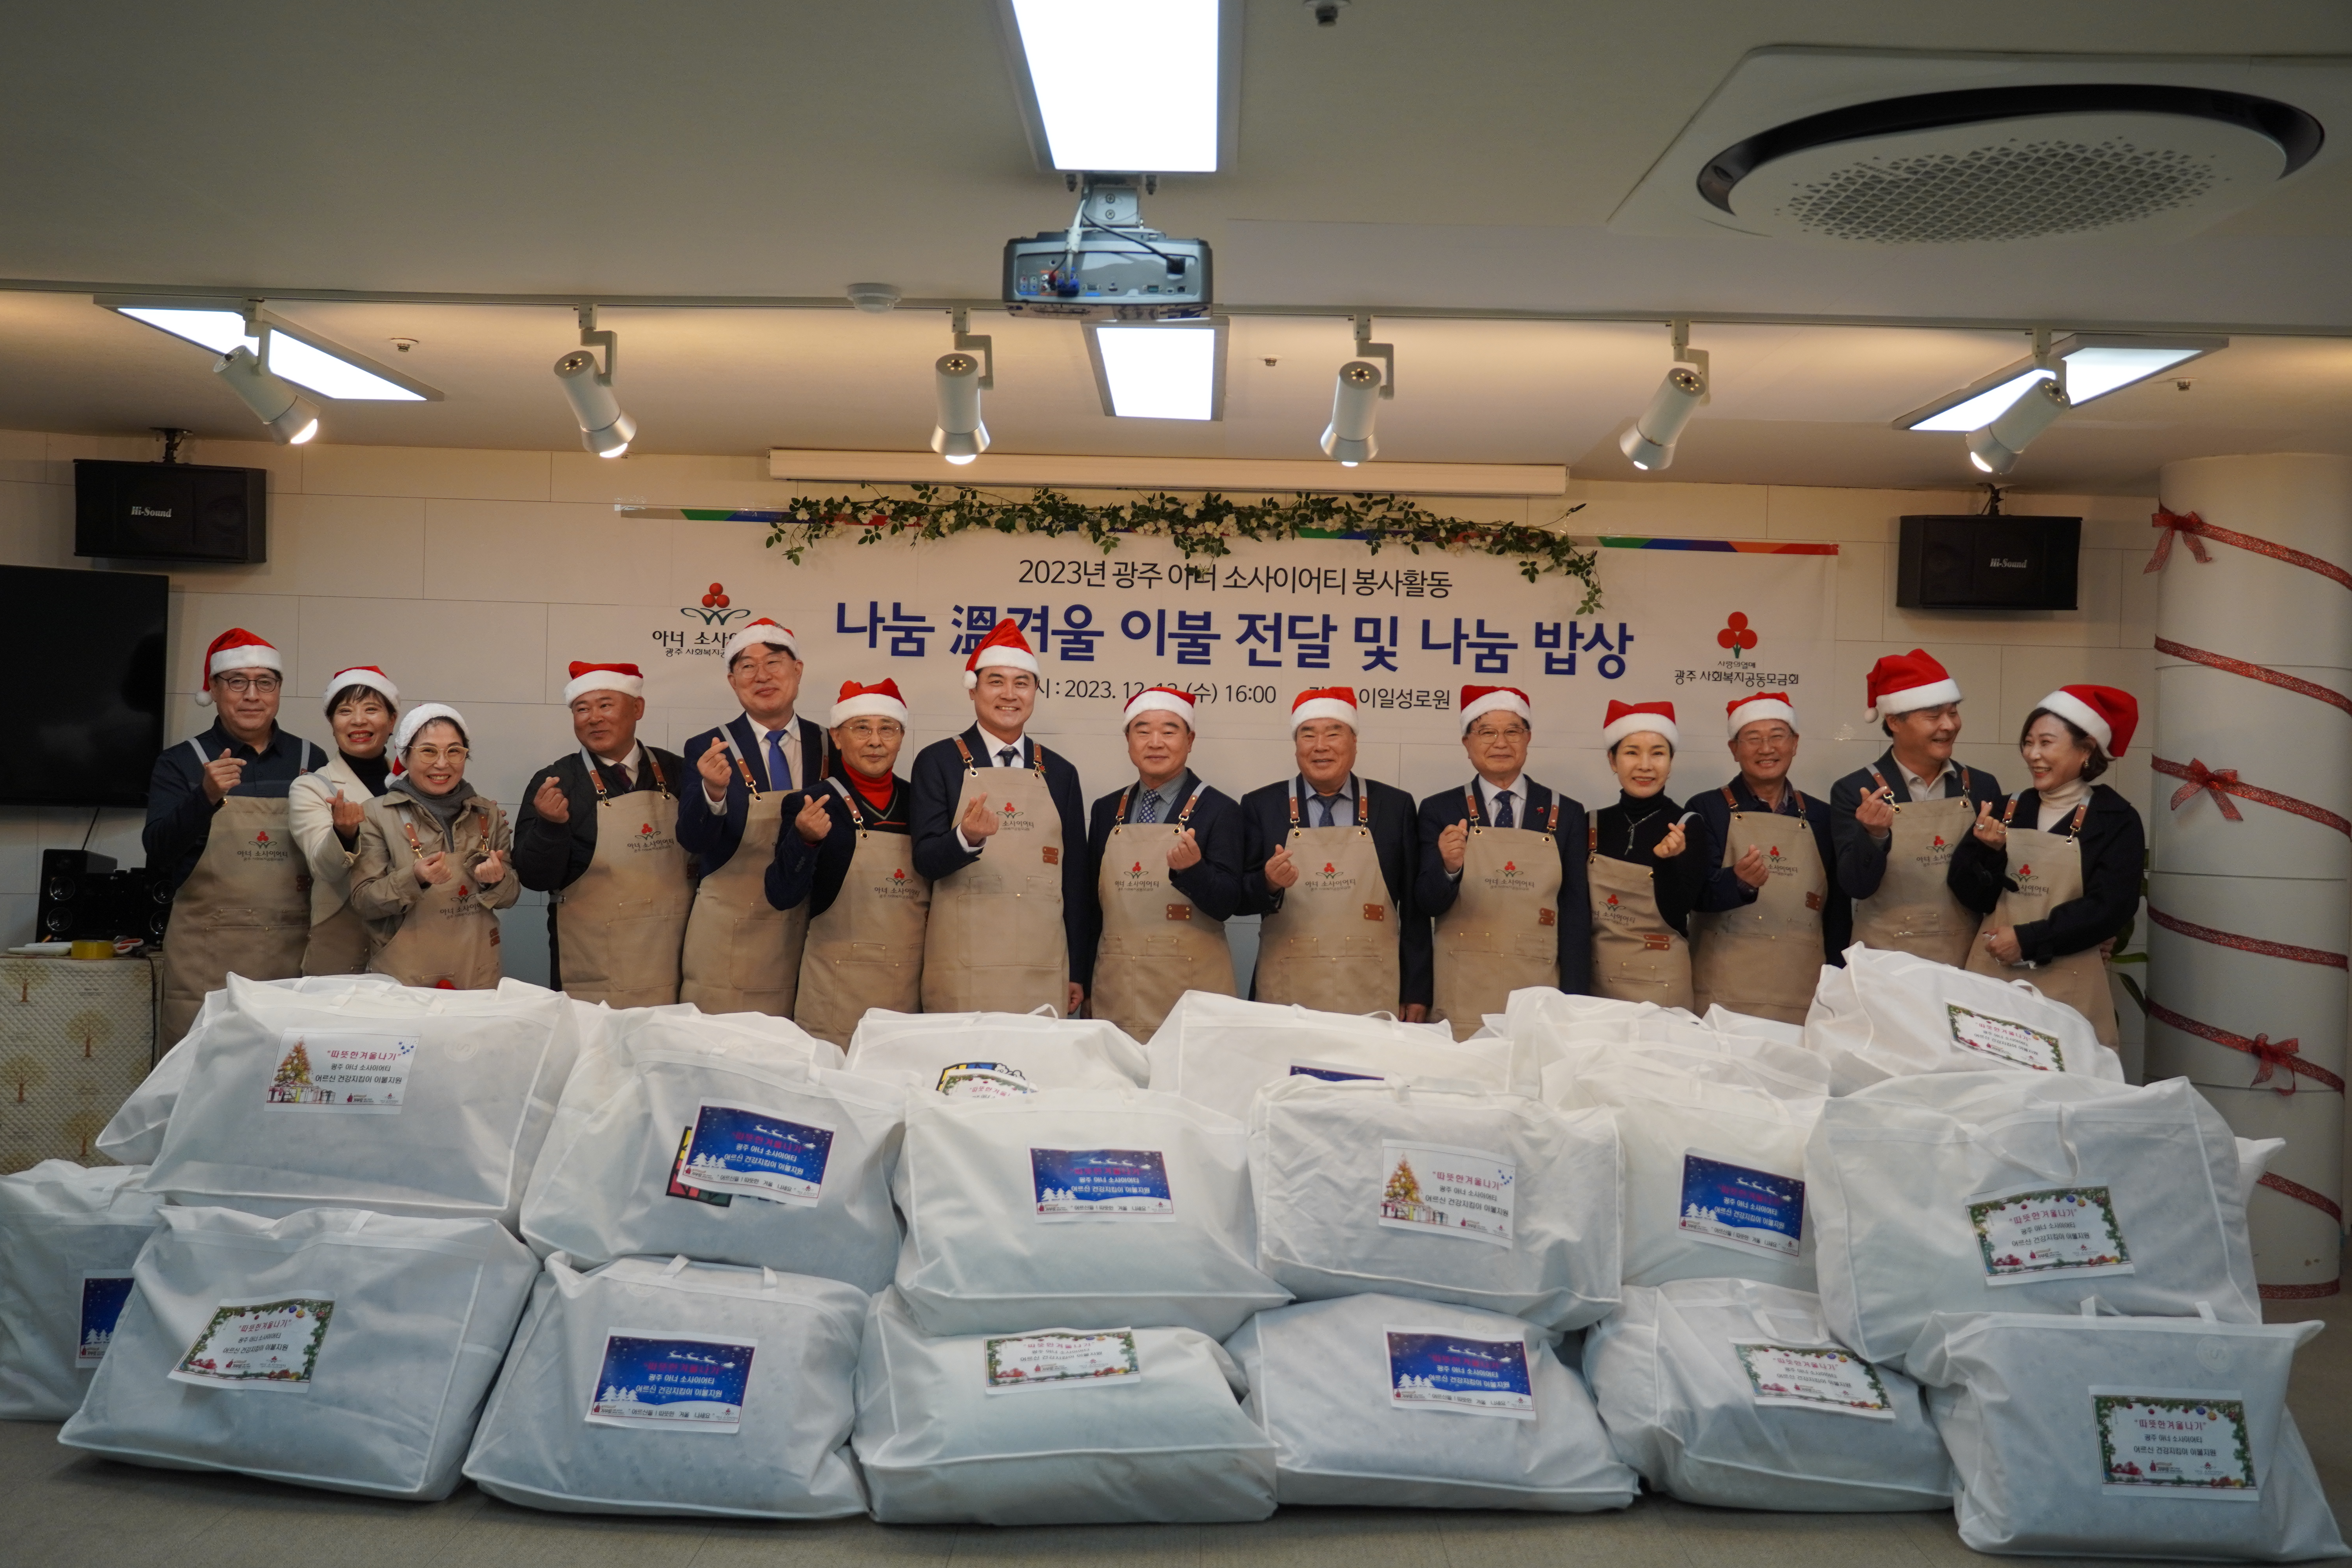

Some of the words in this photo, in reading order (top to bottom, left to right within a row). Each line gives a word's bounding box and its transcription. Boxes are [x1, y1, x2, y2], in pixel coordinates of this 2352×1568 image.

[131, 506, 172, 518] Hi-Sound
[1989, 558, 2027, 568] Hi-Sound
[1019, 559, 1105, 587] 2023년
[1112, 561, 1163, 589] 광주
[1168, 563, 1216, 591] 아너
[1223, 565, 1346, 595] 소사이어티
[1352, 568, 1453, 598] 봉사활동
[652, 630, 684, 648] 아너
[837, 601, 935, 657] 나눔
[1121, 609, 1221, 665] 이불
[1235, 612, 1338, 669] 전달
[1354, 616, 1399, 672] 및
[1421, 618, 1518, 674] 나눔
[1535, 621, 1634, 679] 밥상
[665, 648, 683, 657] 광주
[1717, 661, 1756, 669] 사랑의열매
[1675, 670, 1696, 685] 광주
[1700, 671, 1799, 688] 사회복지공동모금회
[1065, 680, 1116, 699] 2023.
[1186, 682, 1218, 704] (수)
[1225, 684, 1276, 703] 16:00
[1359, 688, 1450, 710] 이일성로원
[1002, 820, 1034, 829] 소사이어티
[643, 838, 674, 848] 소사이어티
[1768, 864, 1798, 873] 소사이어티
[1321, 879, 1356, 887] 소사이어티
[1501, 879, 1534, 887] 소사이어티
[891, 887, 920, 897] 소사이어티
[2021, 885, 2049, 894] 사이어티
[1603, 912, 1635, 923] 소사이어티
[327, 1050, 401, 1061] “따뜻한겨울나기”
[338, 1074, 372, 1083] 건강지킴이
[374, 1076, 402, 1084] 이불지원
[751, 1145, 764, 1154] 아너
[680, 1376, 715, 1385] 소사이어티
[2134, 1419, 2206, 1430] “따뜻한겨울나기”
